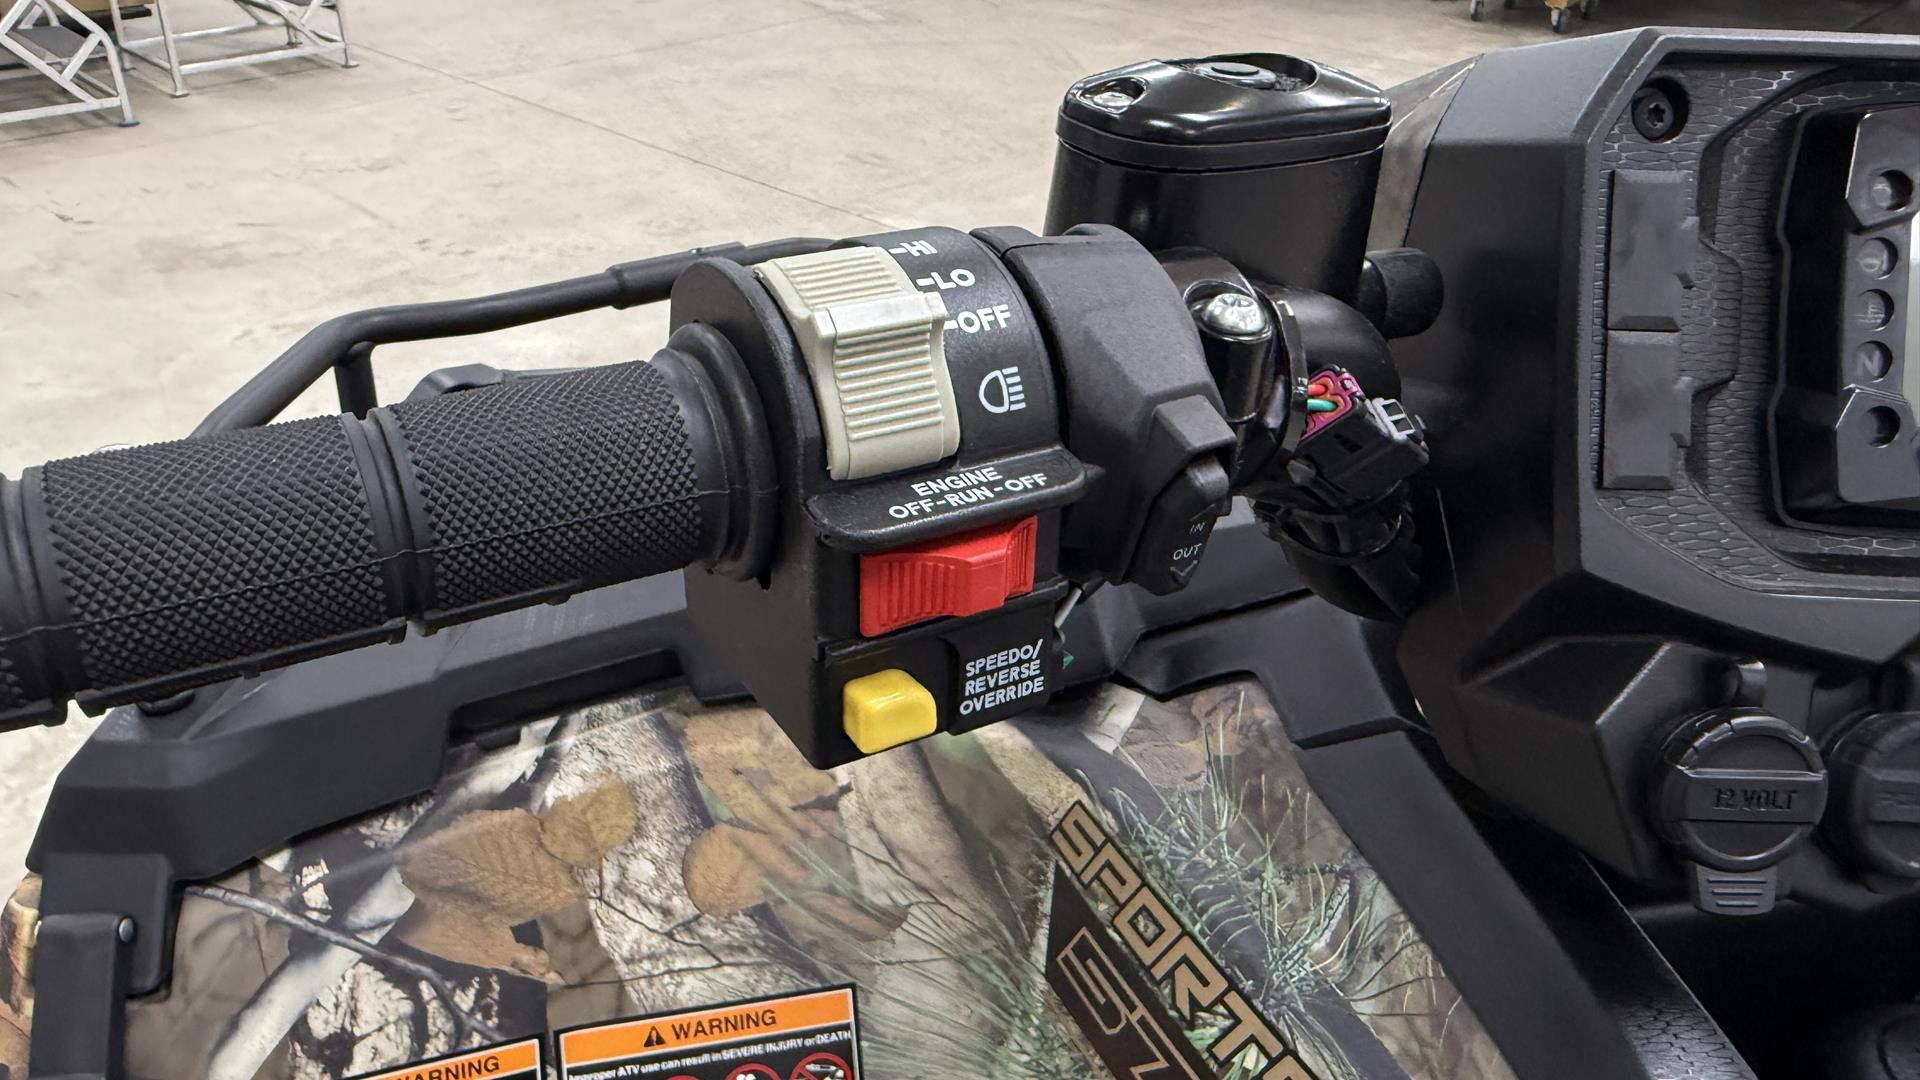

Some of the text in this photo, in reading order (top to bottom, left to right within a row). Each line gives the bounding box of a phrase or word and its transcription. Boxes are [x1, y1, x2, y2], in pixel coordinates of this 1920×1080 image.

[911, 466, 1003, 497] ENGINE
[1173, 543, 1203, 561] OUT
[965, 638, 1044, 677] SPEEDO/
[959, 676, 1045, 715] OVERRIDE
[964, 659, 1041, 697] REVERSE
[1713, 787, 1799, 812] 12 VOLT
[672, 1008, 777, 1041] WARNING
[617, 1064, 640, 1077] ATV
[640, 1063, 661, 1073] use
[661, 1059, 681, 1070] can
[681, 1053, 710, 1067] result
[721, 1044, 765, 1060] SEVERE
[766, 1037, 804, 1053] INJURY
[815, 1030, 852, 1045] DEATH
